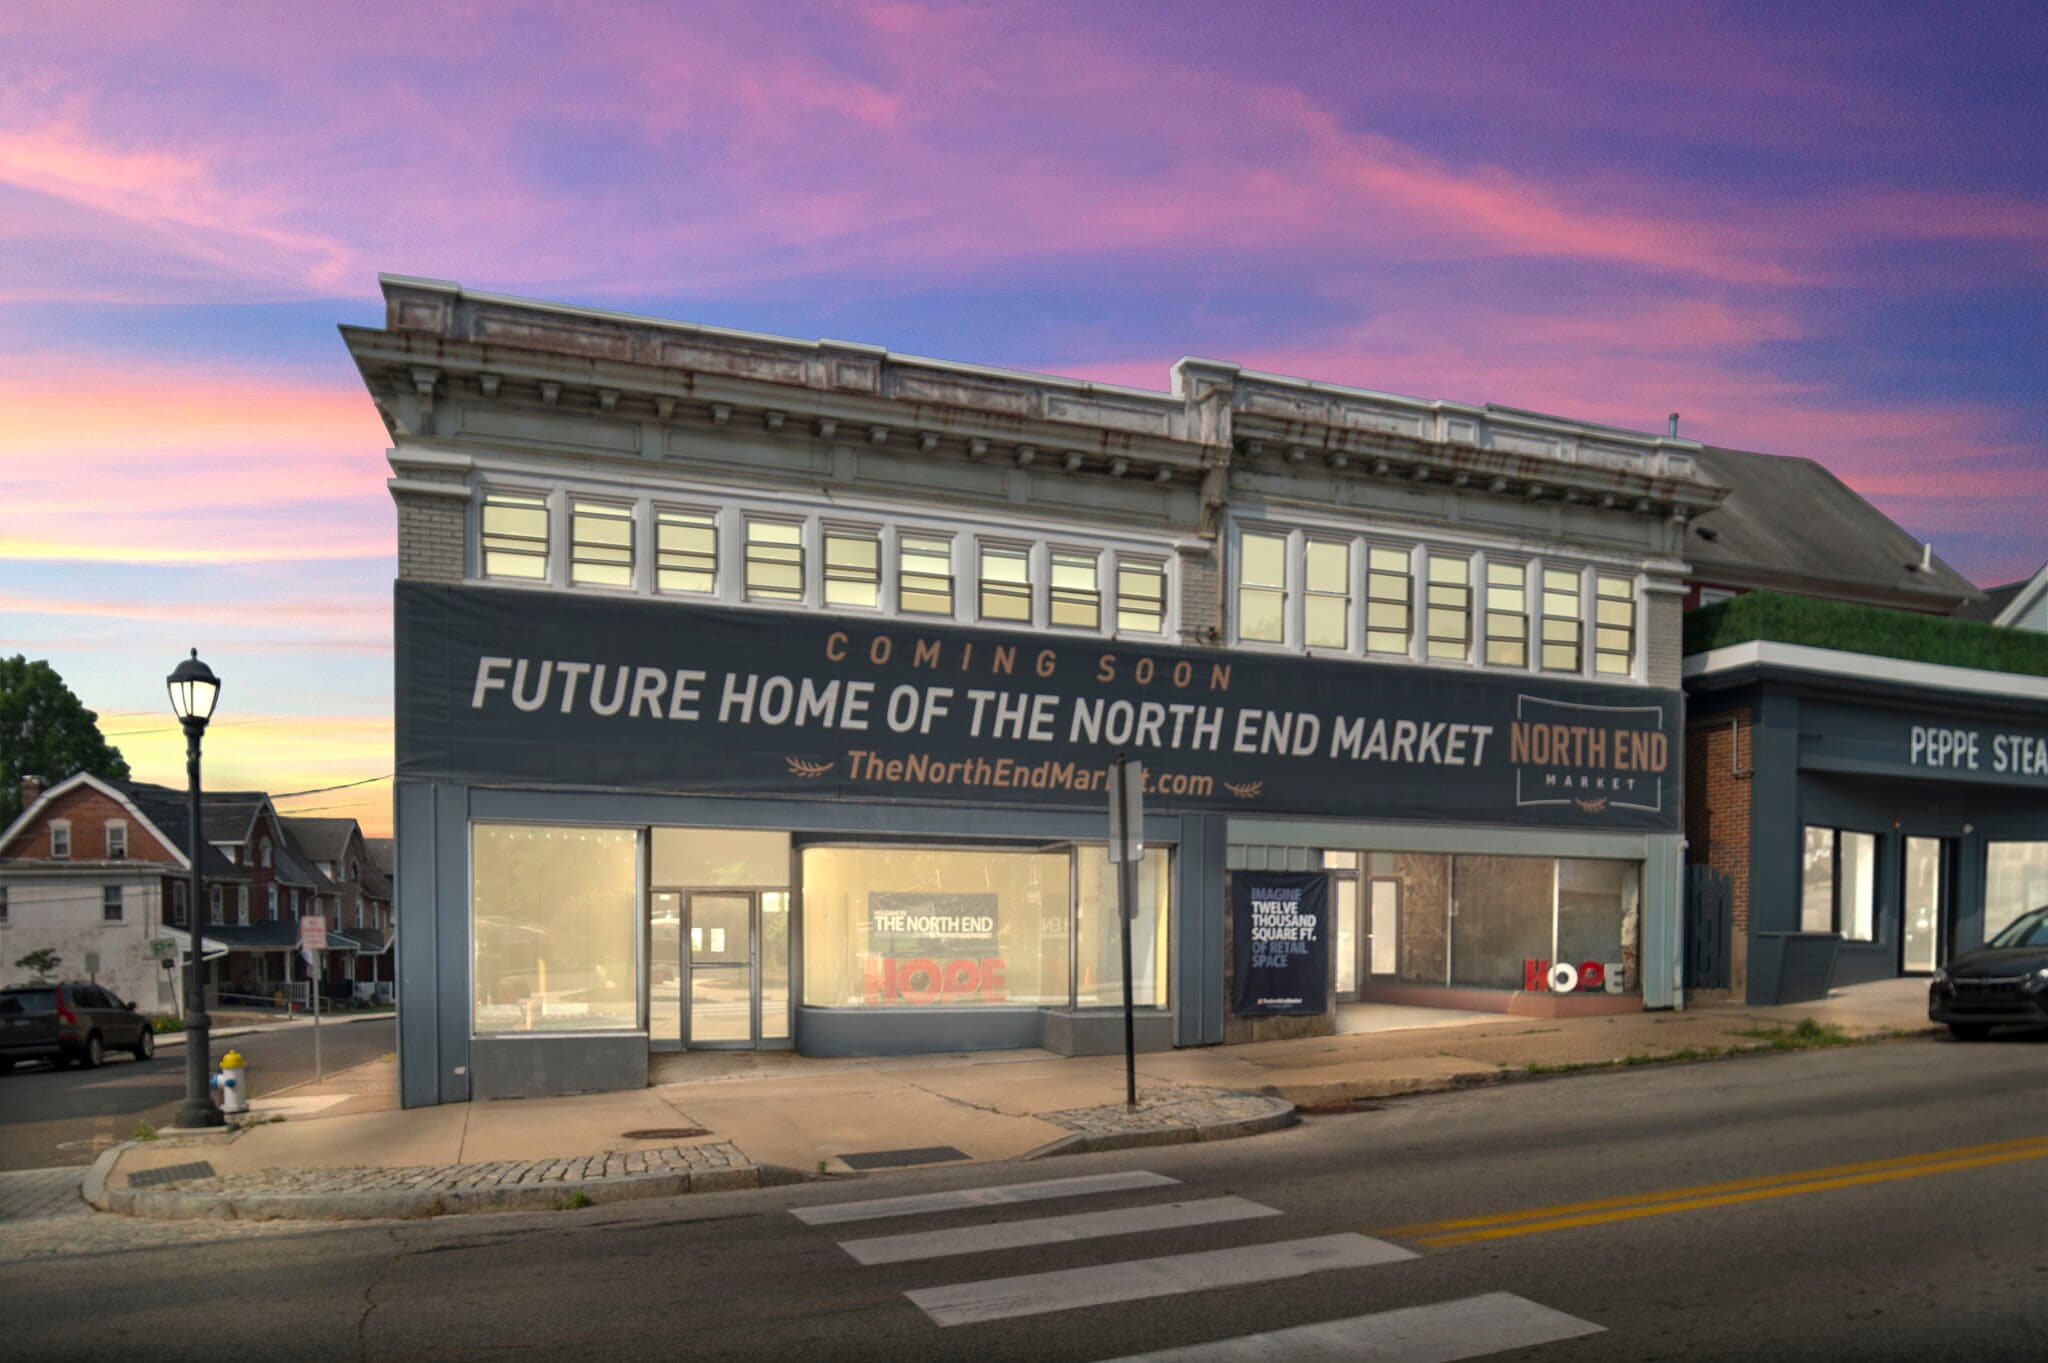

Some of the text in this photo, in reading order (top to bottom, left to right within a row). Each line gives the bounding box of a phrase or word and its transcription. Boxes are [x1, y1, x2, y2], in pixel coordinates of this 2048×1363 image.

[826, 631, 1231, 691] COMING SOON
[471, 656, 1493, 767] FUTURE HOME OF THE NORTH END MARKET
[1510, 721, 1668, 772] NORTH END
[1910, 726, 2048, 776] PEPPE STEA
[848, 750, 1213, 796] TheNorthEndMart.com
[1546, 773, 1636, 791] MARKET
[1251, 887, 1301, 901] IMAGINE
[1252, 901, 1298, 914] TWELVE
[874, 916, 993, 932] THE NORTH END
[1252, 914, 1317, 927] THOUSAND
[1252, 927, 1317, 941] SQUARE FT.
[1252, 941, 1308, 954] OF RETAIL
[1252, 954, 1288, 967] SPACE
[864, 957, 1006, 1004] HOPE
[1524, 959, 1624, 993] HOPE
